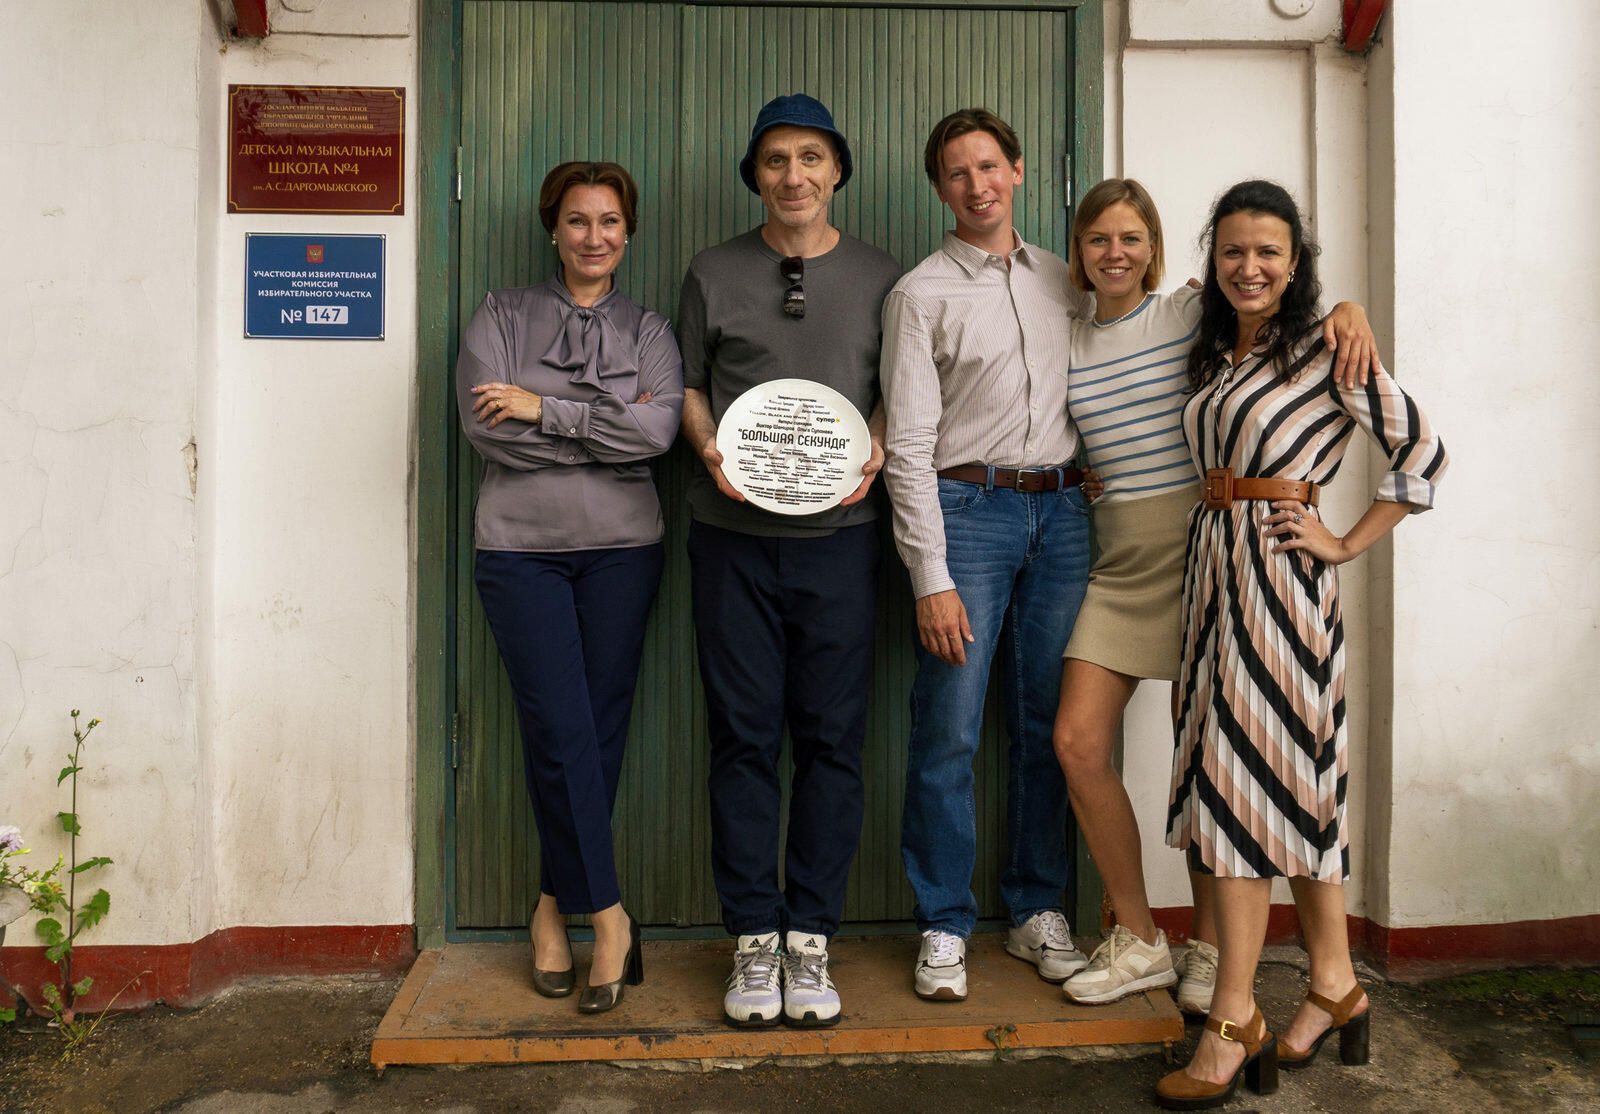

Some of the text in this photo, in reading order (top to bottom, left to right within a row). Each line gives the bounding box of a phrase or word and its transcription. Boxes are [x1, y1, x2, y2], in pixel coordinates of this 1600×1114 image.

[239, 144, 392, 157] ДЕТСКАЯ МУЗЫКАЛЬНАЯ
[268, 162, 329, 175] ШКОЛА
[308, 271, 377, 279] ИЗБИРАТЕЛЬНАЯ
[258, 290, 333, 298] ИЗБИРАТЕЛЬНОГО
[312, 308, 341, 323] 147
[816, 416, 836, 424] супер
